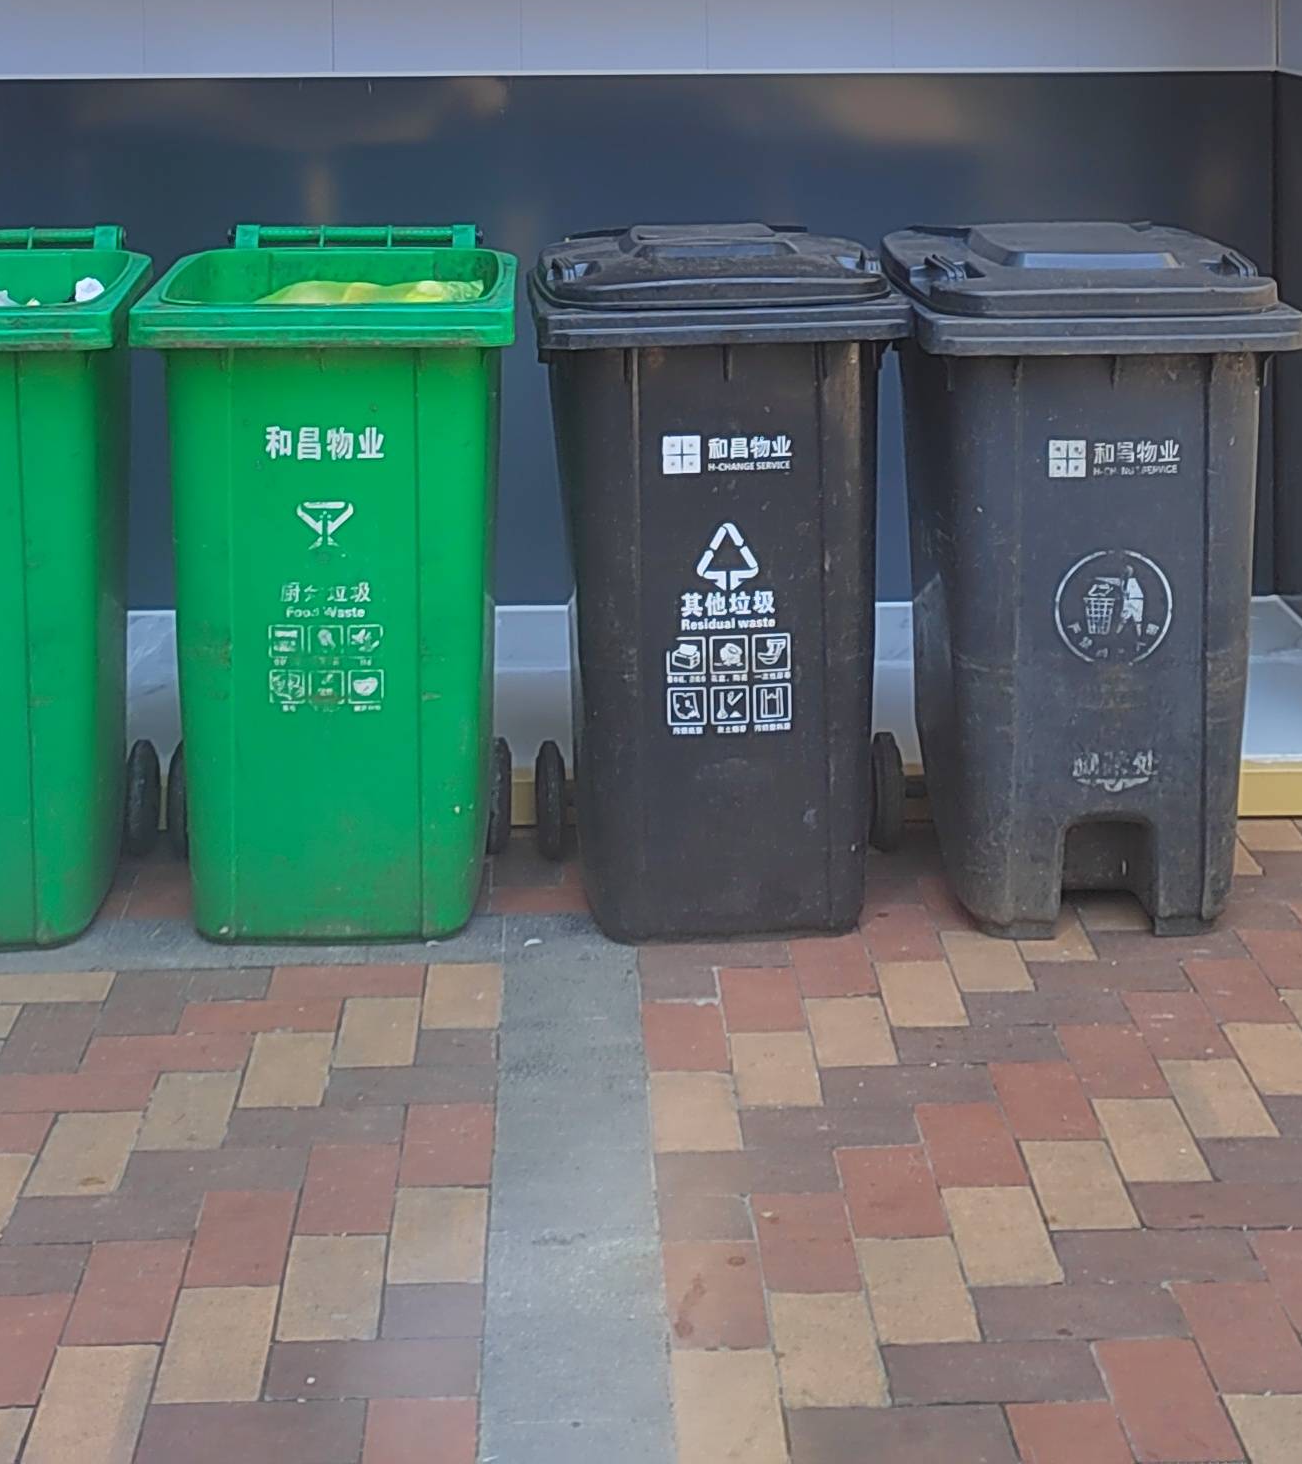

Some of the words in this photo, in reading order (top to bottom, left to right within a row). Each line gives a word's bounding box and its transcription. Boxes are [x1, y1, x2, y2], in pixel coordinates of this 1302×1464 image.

[265, 425, 385, 461] 和昌物业
[707, 434, 793, 459] 和昌物业
[1093, 439, 1181, 464] 和昌物业
[707, 461, 755, 472] H-CHANGE
[756, 460, 791, 471] SERVICE
[680, 590, 776, 618] 其他垃圾
[681, 617, 736, 631] Residual
[738, 617, 776, 628] waste
